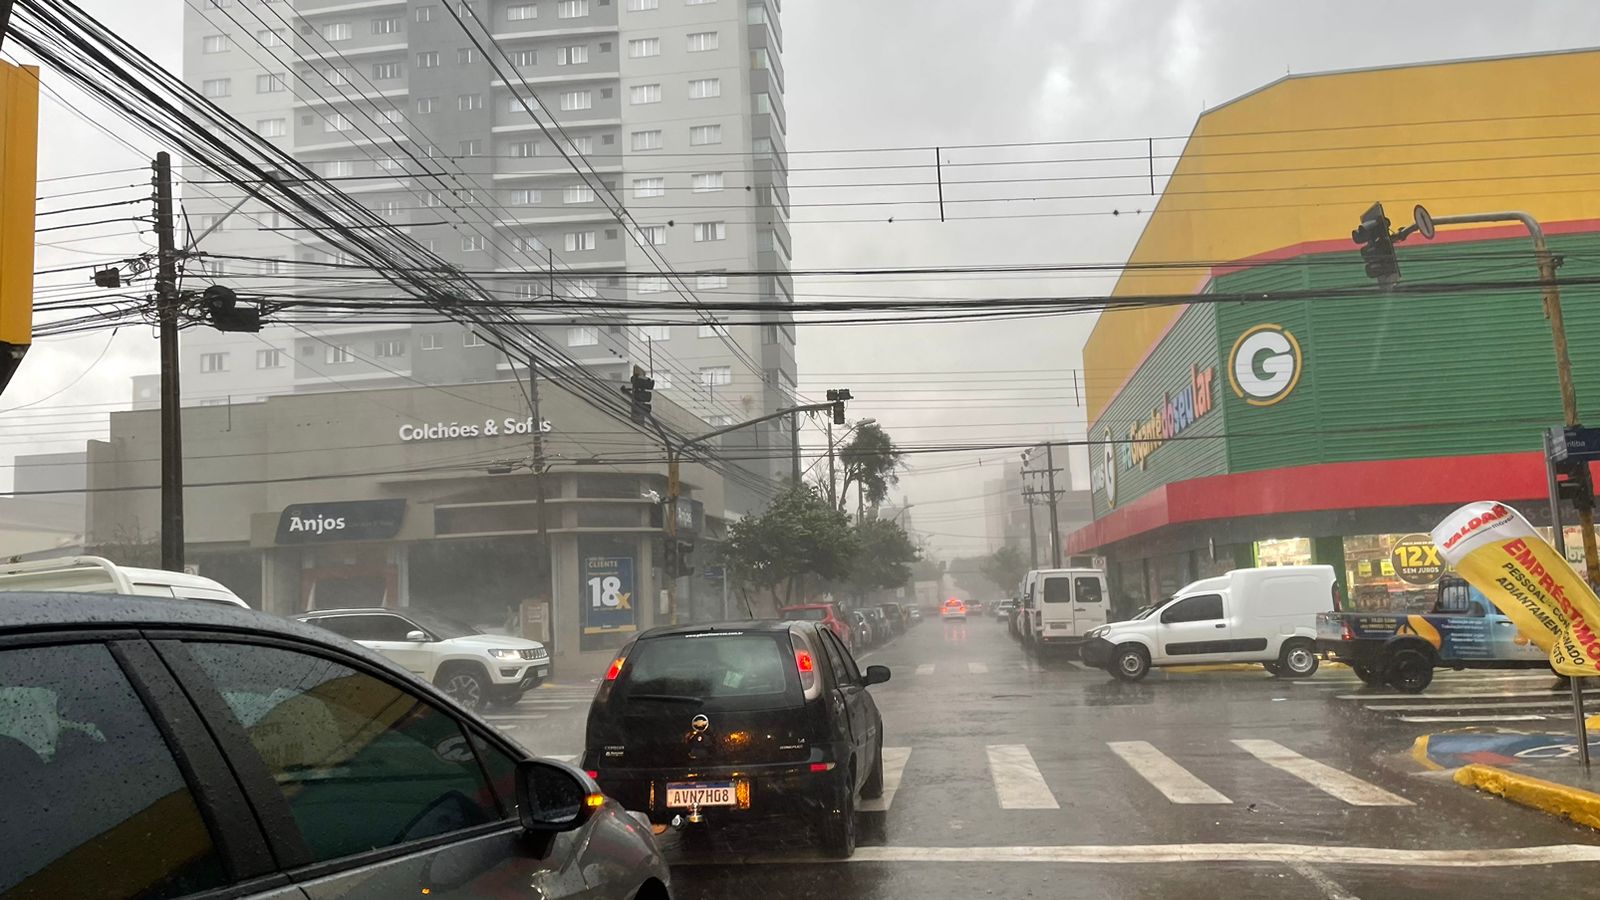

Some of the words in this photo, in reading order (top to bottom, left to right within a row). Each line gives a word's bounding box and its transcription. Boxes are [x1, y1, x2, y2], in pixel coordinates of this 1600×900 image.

[1235, 331, 1294, 397] G
[399, 422, 479, 441] Colchões
[484, 419, 498, 435] &
[289, 514, 345, 534] Anjos
[1443, 504, 1508, 549] VALDAR
[1395, 545, 1441, 567] 12X
[1402, 567, 1417, 575] SEM
[1502, 562, 1548, 604] PESSOAL
[673, 789, 730, 804] AVN7H08
